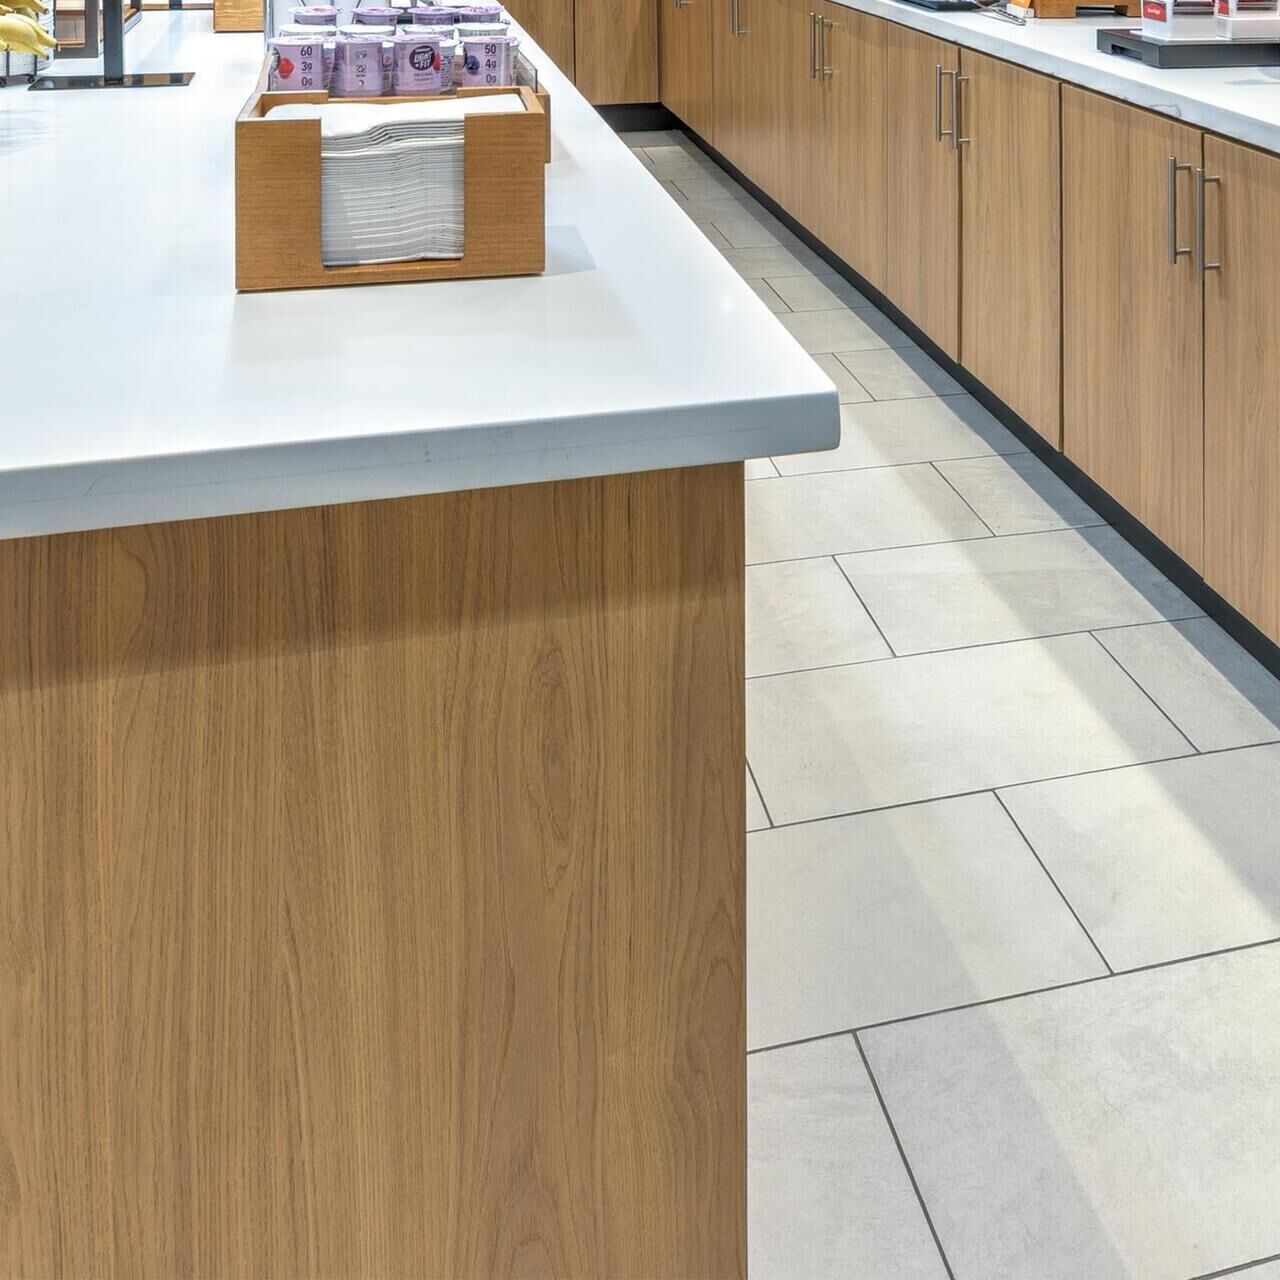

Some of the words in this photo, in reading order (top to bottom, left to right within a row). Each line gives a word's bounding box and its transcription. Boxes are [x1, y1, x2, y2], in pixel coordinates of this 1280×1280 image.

[300, 46, 313, 56] 60
[484, 44, 496, 54] 50
[301, 62, 312, 72] 3g
[485, 59, 496, 69] 4g
[301, 77, 312, 87] 0g
[485, 74, 496, 84] 0g
